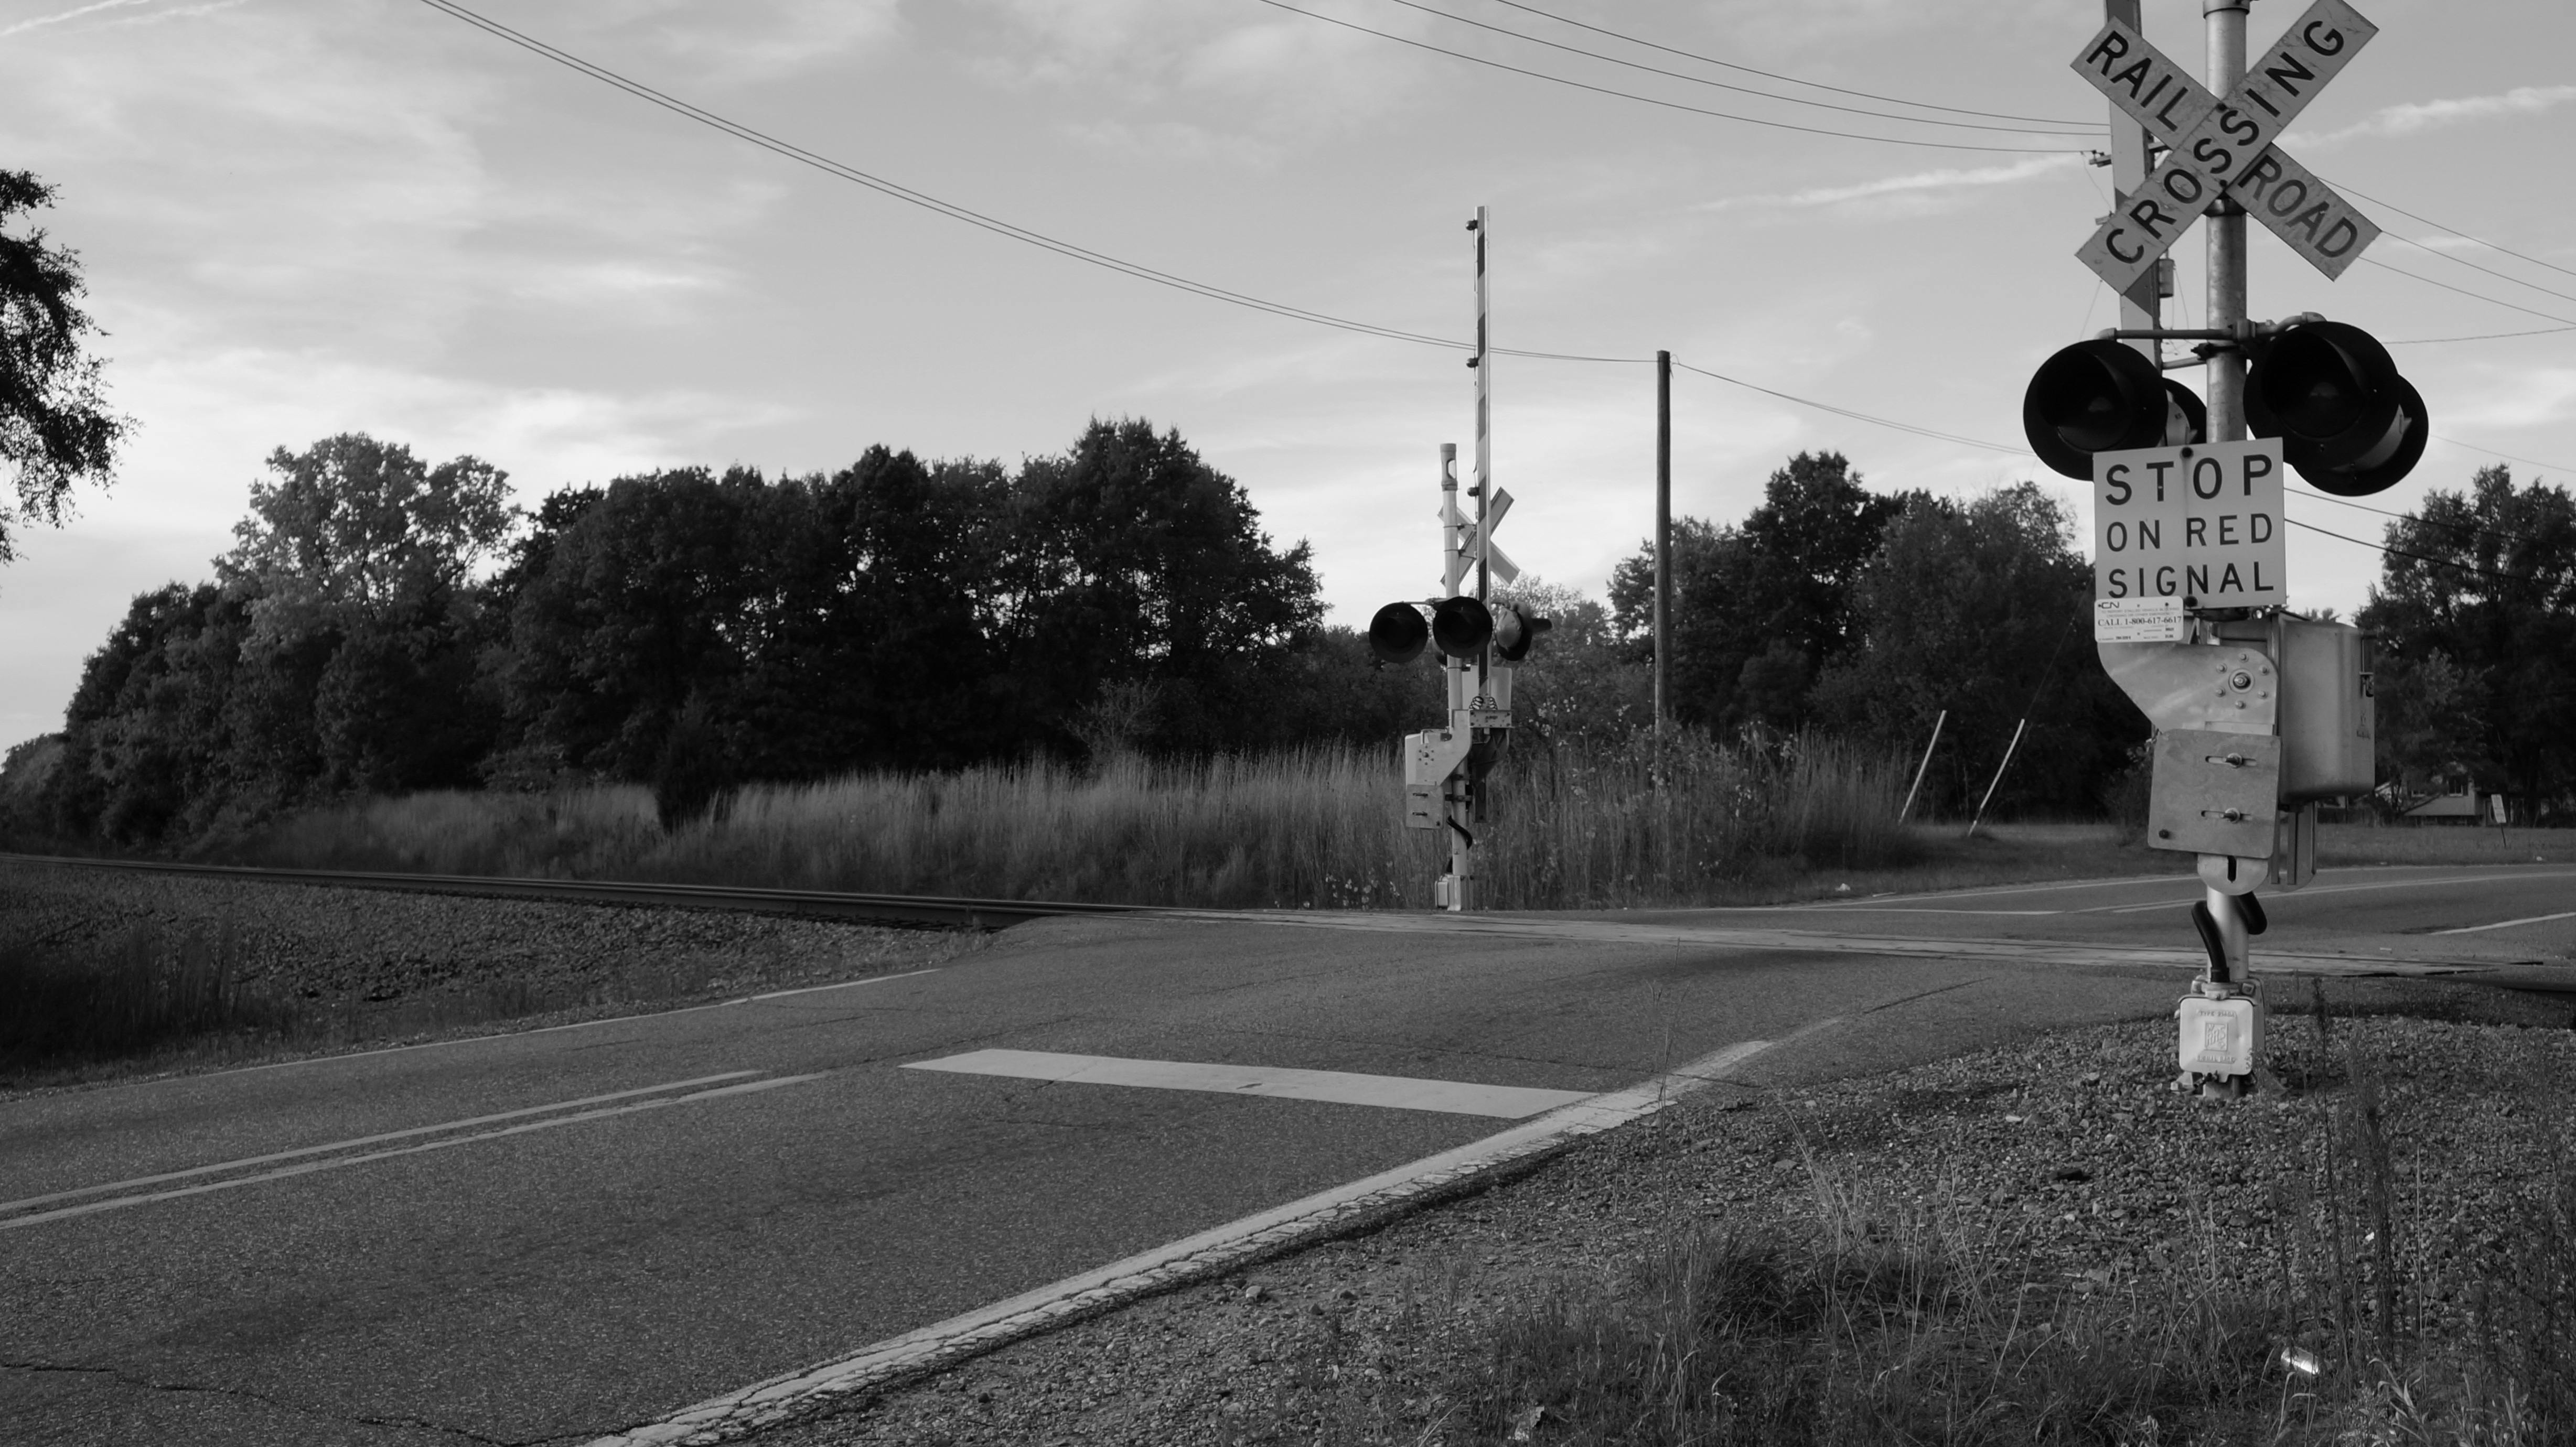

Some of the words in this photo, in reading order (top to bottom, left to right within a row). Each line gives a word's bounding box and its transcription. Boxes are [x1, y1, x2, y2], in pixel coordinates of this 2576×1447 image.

[2086, 29, 2188, 132] RAIL
[2237, 154, 2358, 258] ROAD
[2106, 20, 2345, 264] CROSSING
[2105, 453, 2272, 506] STOP
[2107, 519, 2161, 552] ON
[2186, 513, 2272, 548] RED
[2107, 561, 2274, 599] SIGNAL
[2098, 618, 2123, 627] CALL
[2125, 615, 2182, 625] 1-800-617-6617
